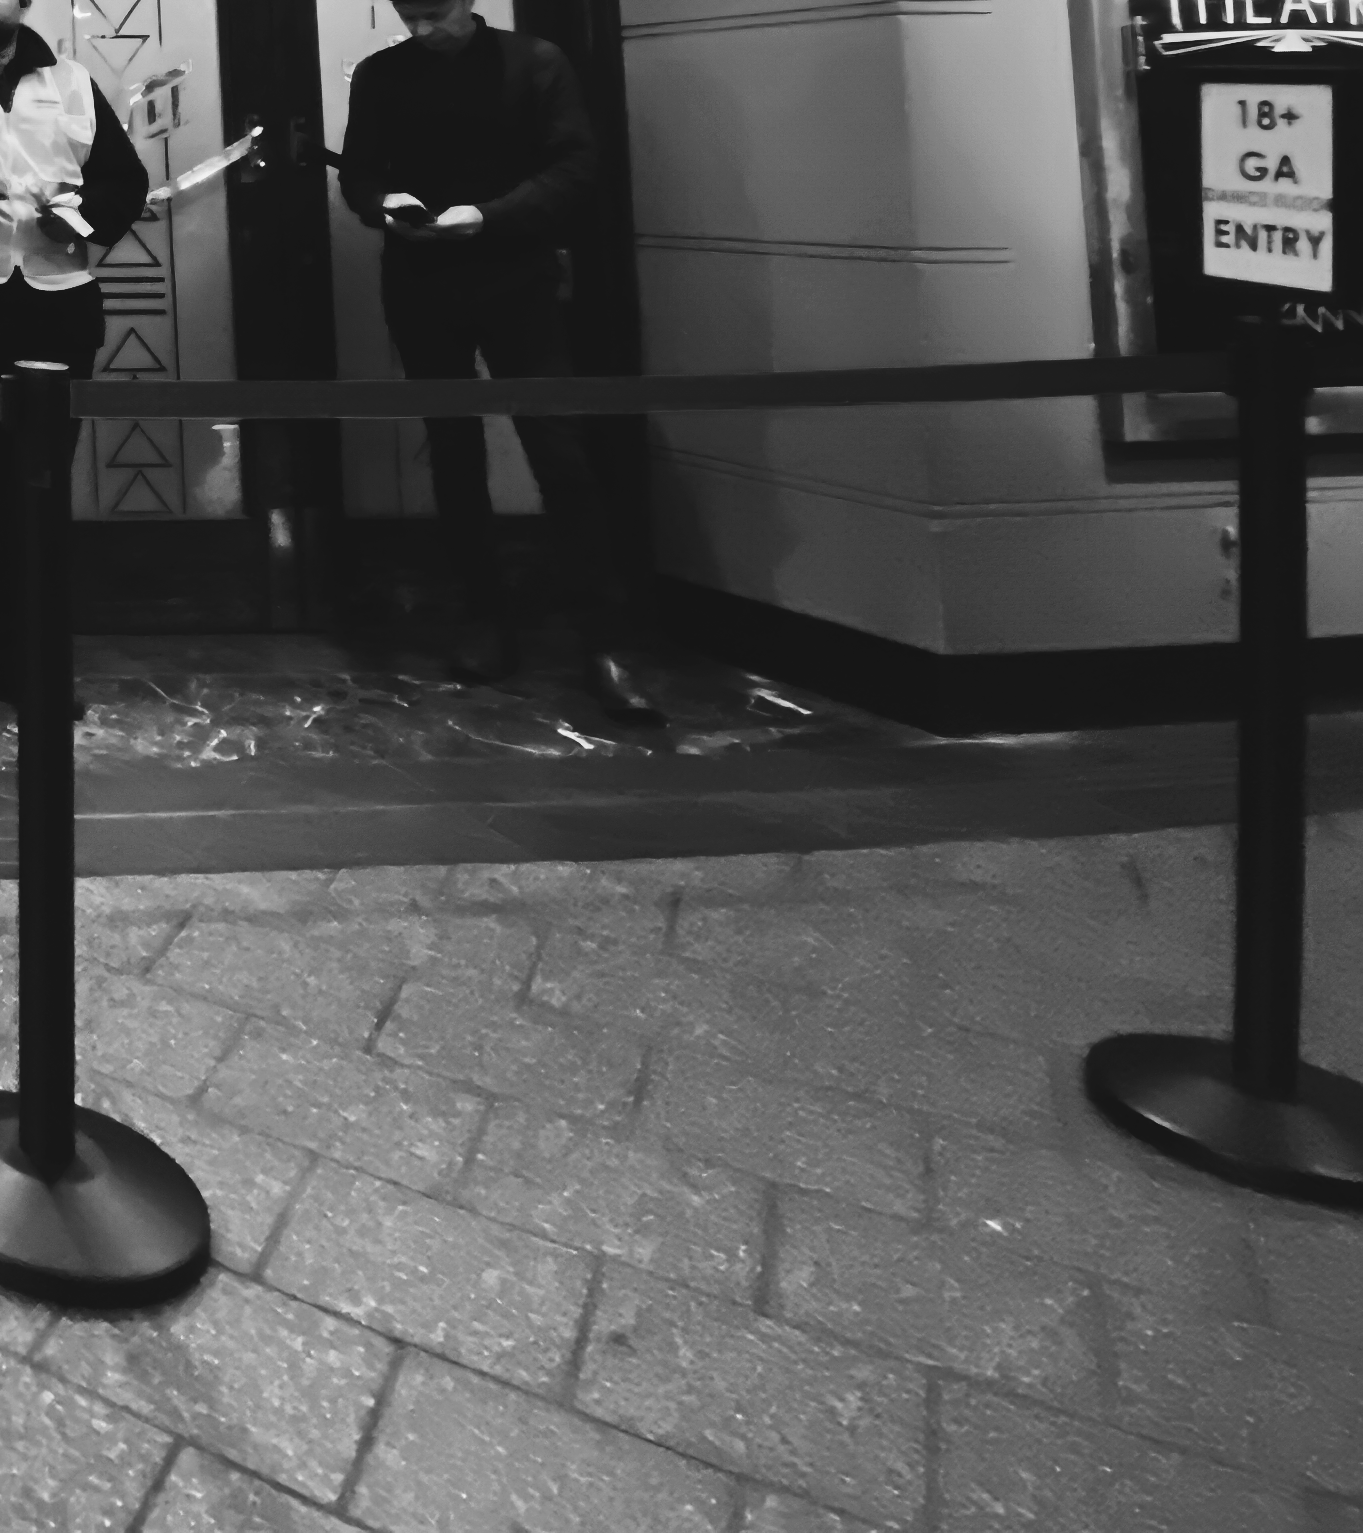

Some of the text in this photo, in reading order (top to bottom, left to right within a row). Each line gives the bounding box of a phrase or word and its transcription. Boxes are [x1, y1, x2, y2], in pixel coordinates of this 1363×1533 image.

[1236, 99, 1301, 131] 18+
[1238, 150, 1299, 185] GA
[1213, 218, 1326, 261] ENTRY
